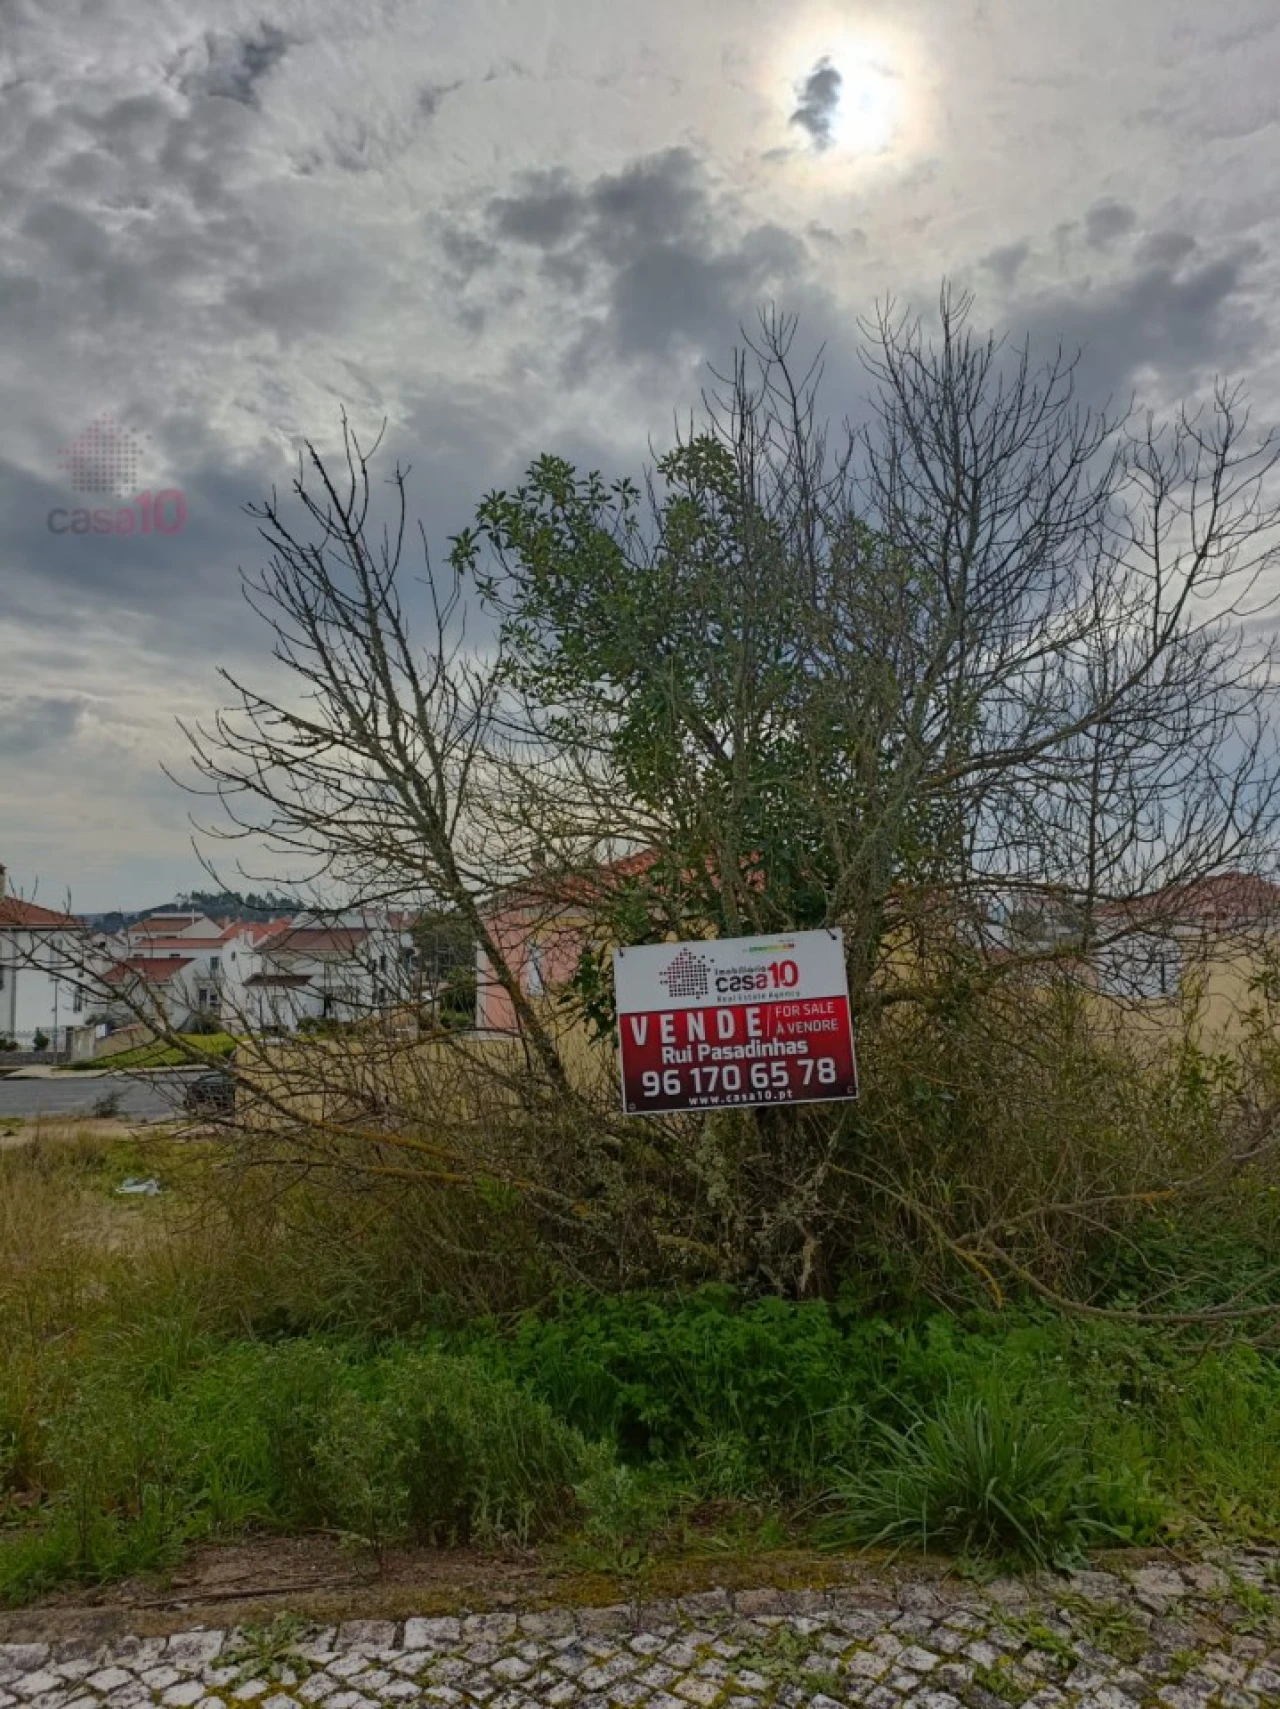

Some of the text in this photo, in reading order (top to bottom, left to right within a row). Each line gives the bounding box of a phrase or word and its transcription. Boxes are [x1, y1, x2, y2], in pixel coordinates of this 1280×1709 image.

[715, 960, 799, 993] casa10
[776, 1002, 835, 1018] FOR SALE
[631, 1007, 762, 1045] VENDE
[787, 1018, 839, 1034] VENDRE
[662, 1037, 808, 1064] Rui Pasadinhas
[642, 1057, 836, 1097] 96 170 65 78
[688, 1090, 793, 1105] www.casa10.pt
